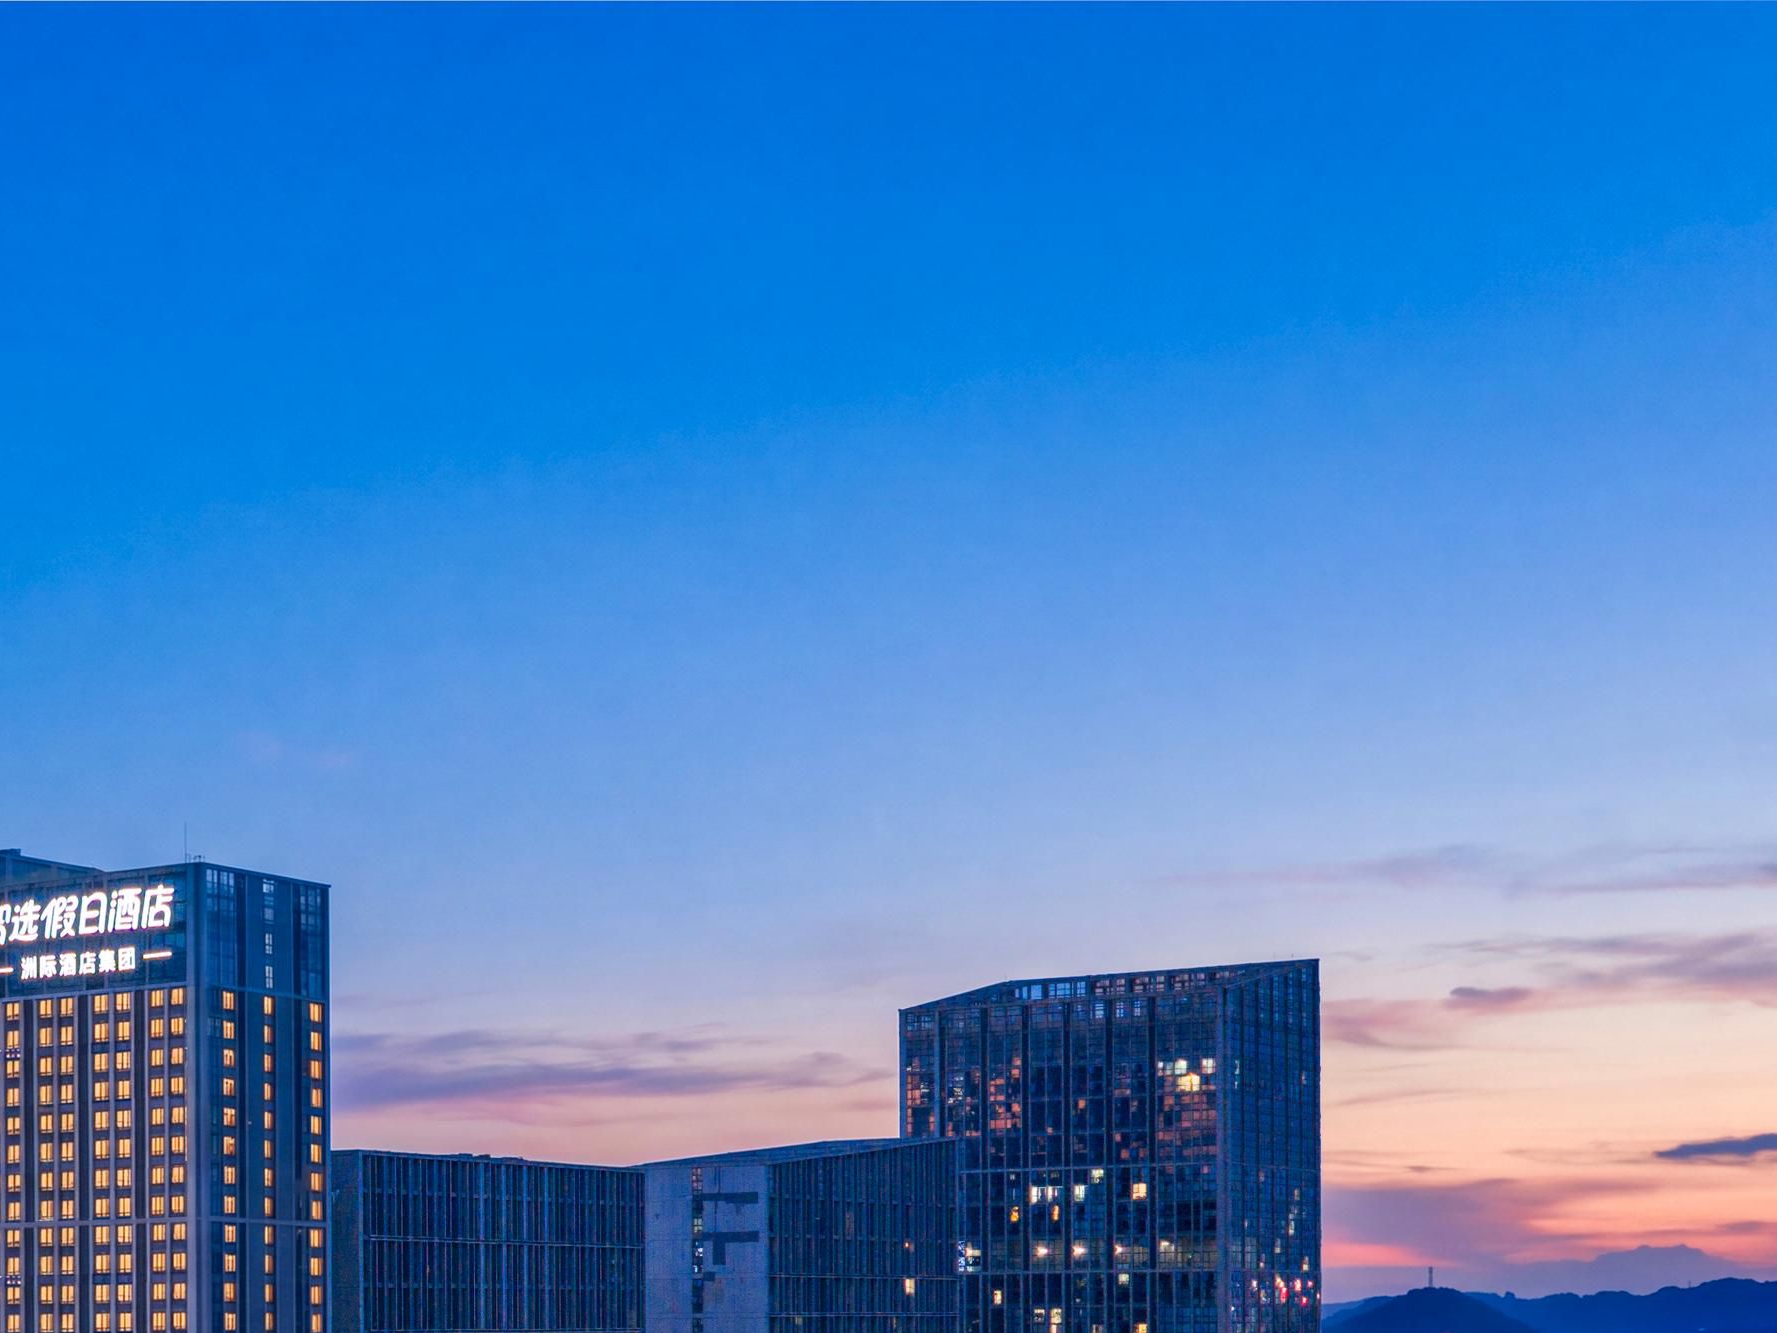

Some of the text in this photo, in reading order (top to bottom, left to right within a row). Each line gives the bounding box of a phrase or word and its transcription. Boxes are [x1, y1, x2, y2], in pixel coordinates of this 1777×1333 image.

[20, 947, 136, 980] 洲际酒店集团
